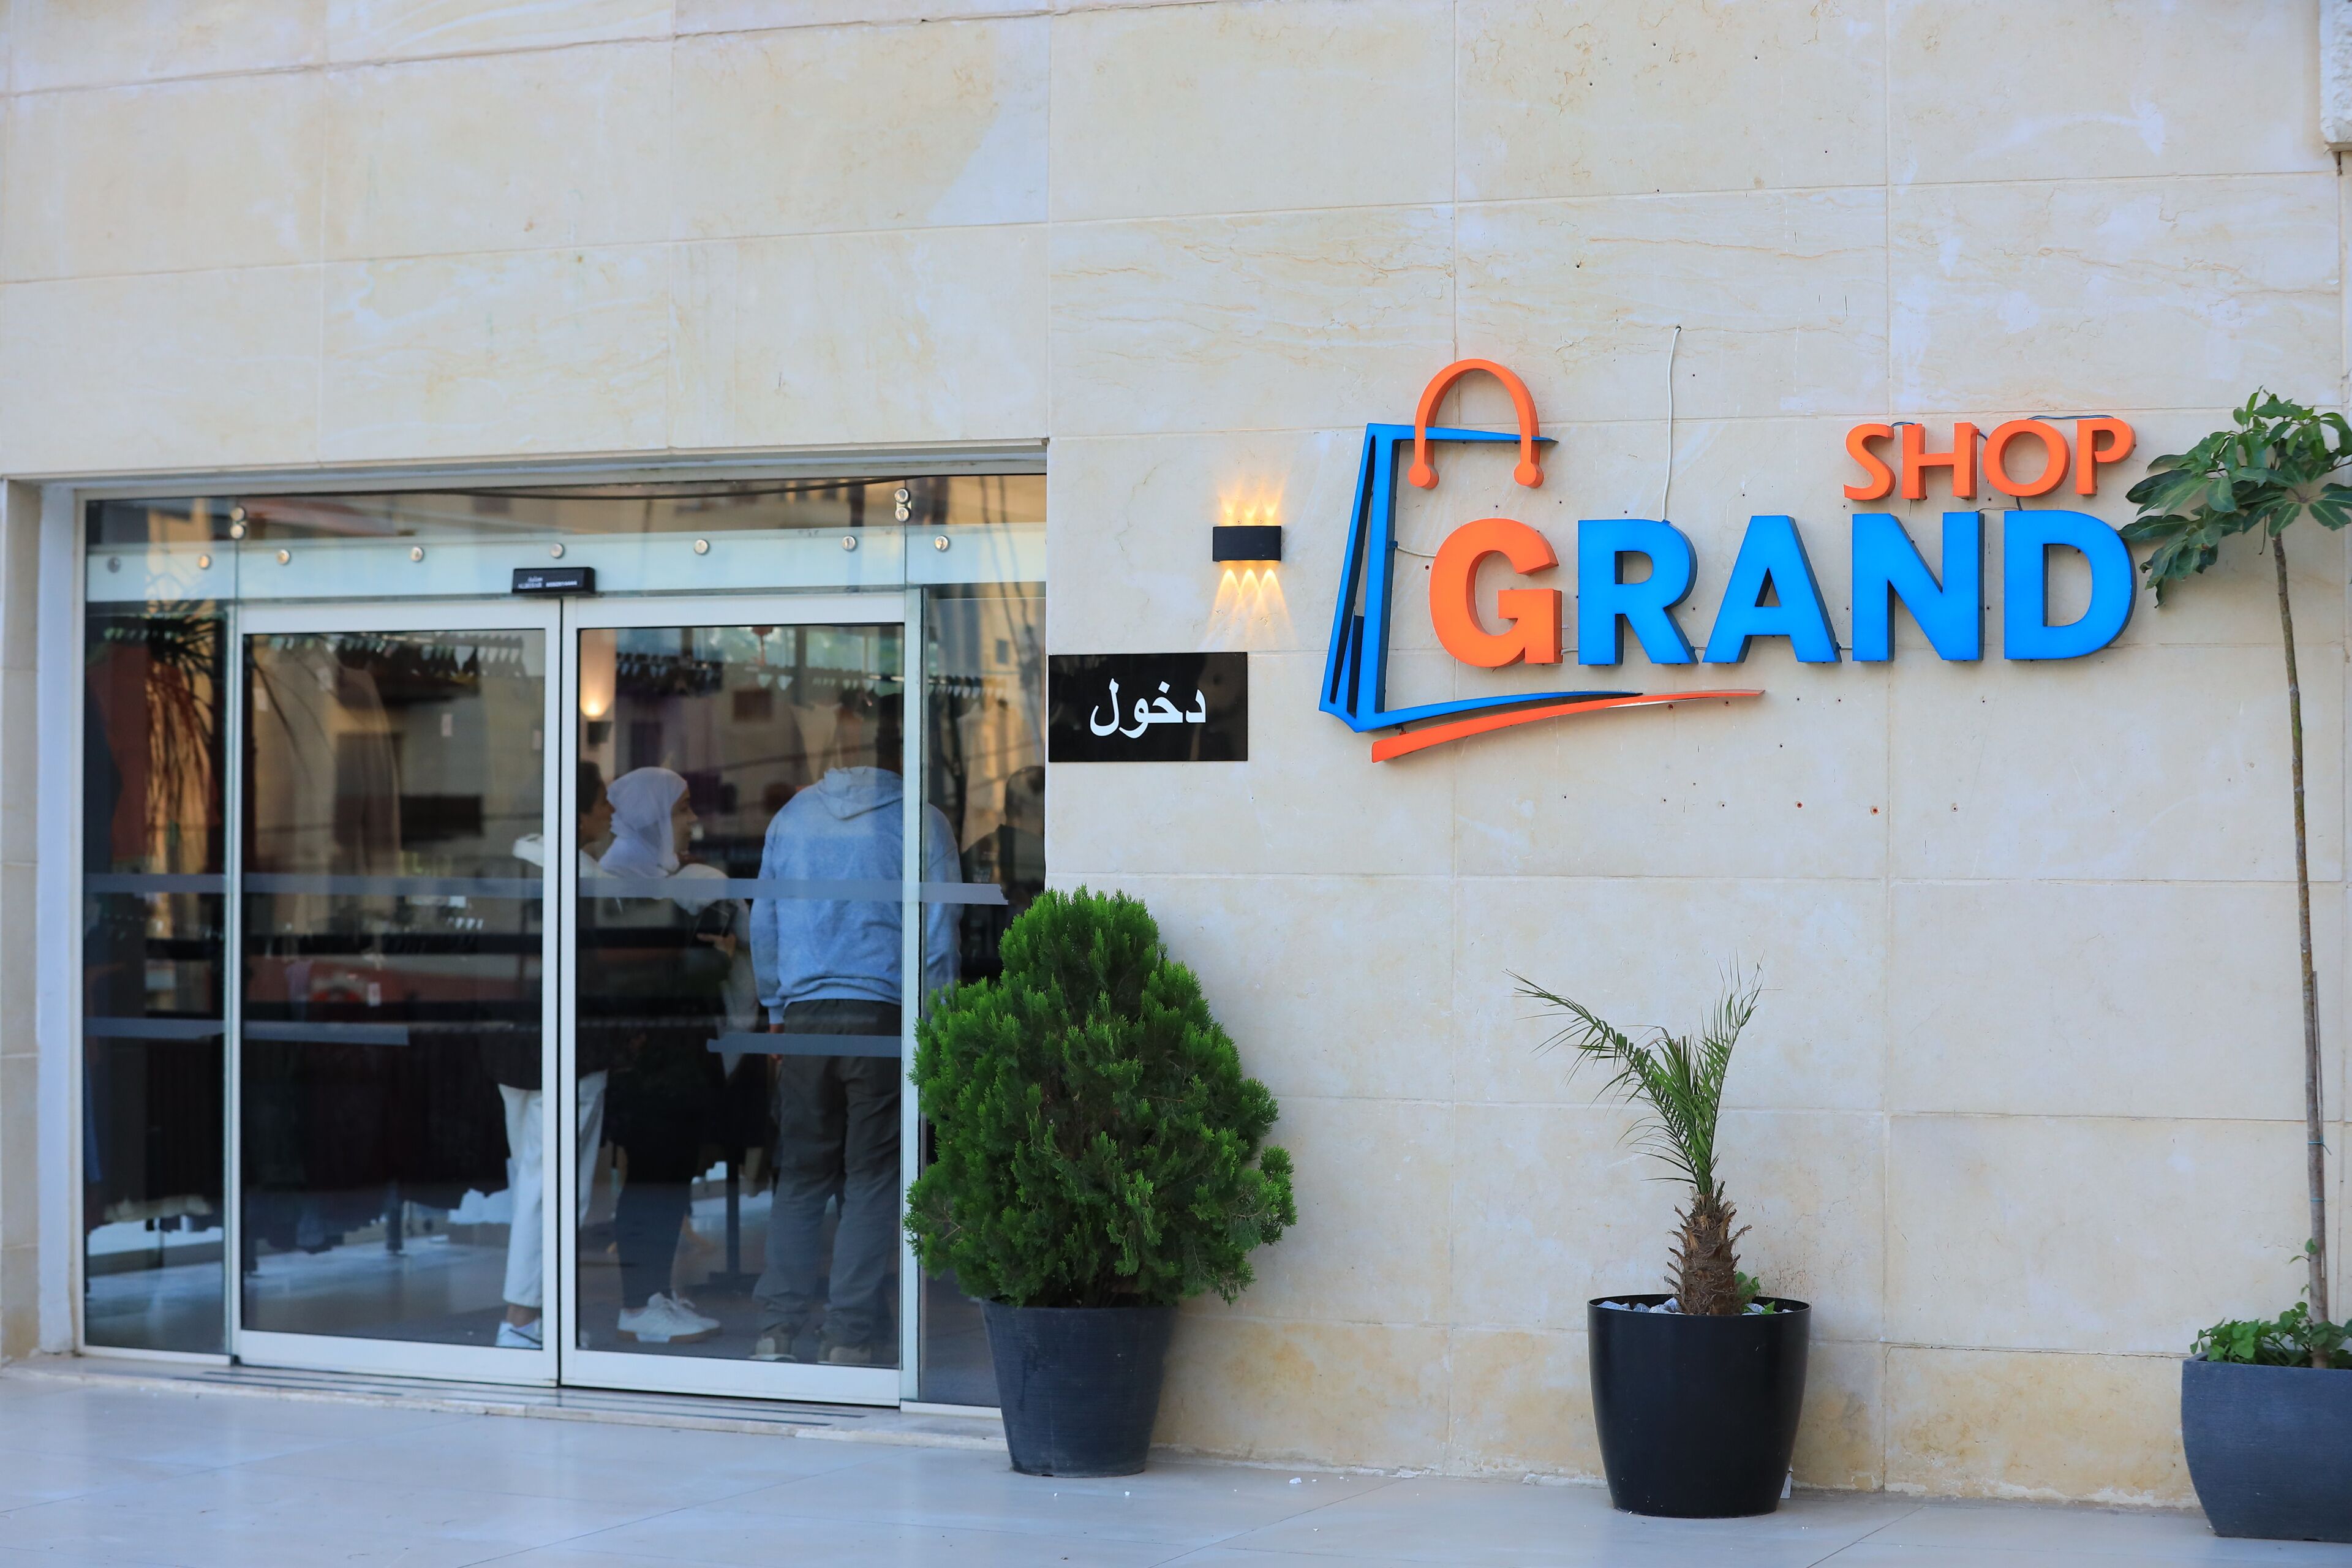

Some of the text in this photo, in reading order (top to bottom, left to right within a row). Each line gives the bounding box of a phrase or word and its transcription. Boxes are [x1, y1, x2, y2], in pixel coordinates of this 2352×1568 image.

[1843, 418, 2136, 501] SHOP
[1429, 510, 2137, 668] GRAND
[1090, 677, 1206, 739] دخول
